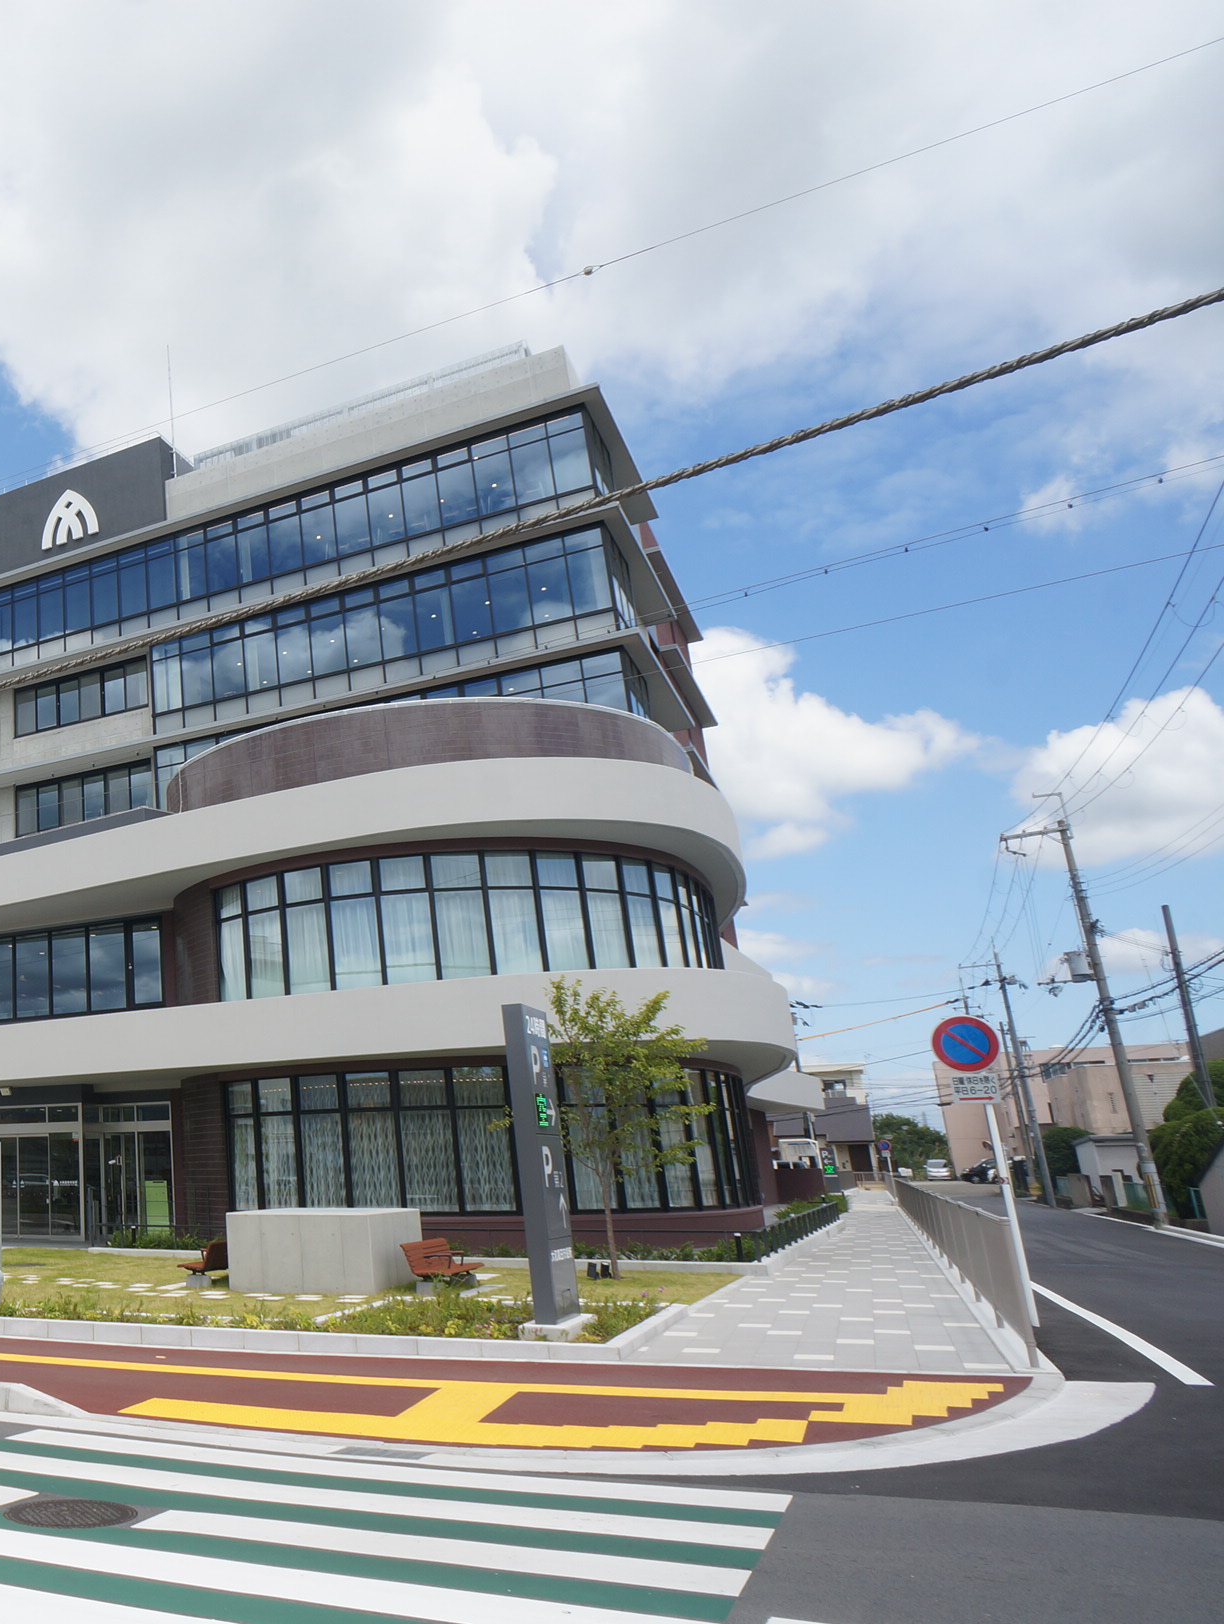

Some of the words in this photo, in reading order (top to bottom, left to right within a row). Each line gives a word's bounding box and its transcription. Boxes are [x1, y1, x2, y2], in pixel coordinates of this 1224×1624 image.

[525, 1015, 546, 1039] 24時間
[530, 1045, 540, 1085] P
[541, 1145, 553, 1188] P
